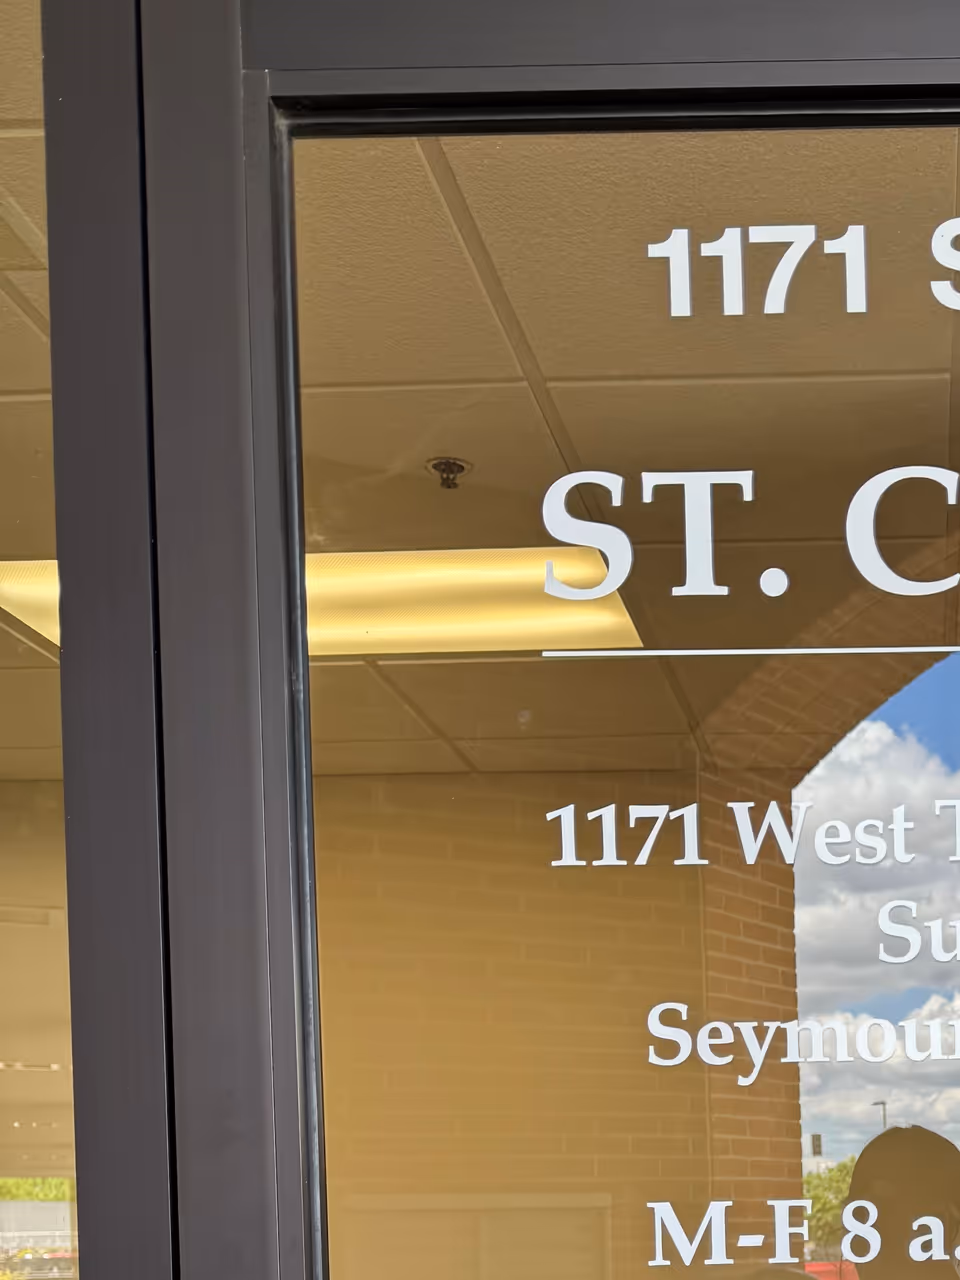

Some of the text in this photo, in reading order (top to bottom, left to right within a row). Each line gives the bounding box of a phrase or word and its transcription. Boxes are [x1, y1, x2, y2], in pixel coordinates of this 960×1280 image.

[647, 224, 866, 317] 1171
[541, 470, 789, 601] ST.
[545, 802, 709, 867] 1171
[728, 799, 916, 866] West
[647, 1199, 812, 1267] M-F
[841, 1199, 882, 1264] 8
